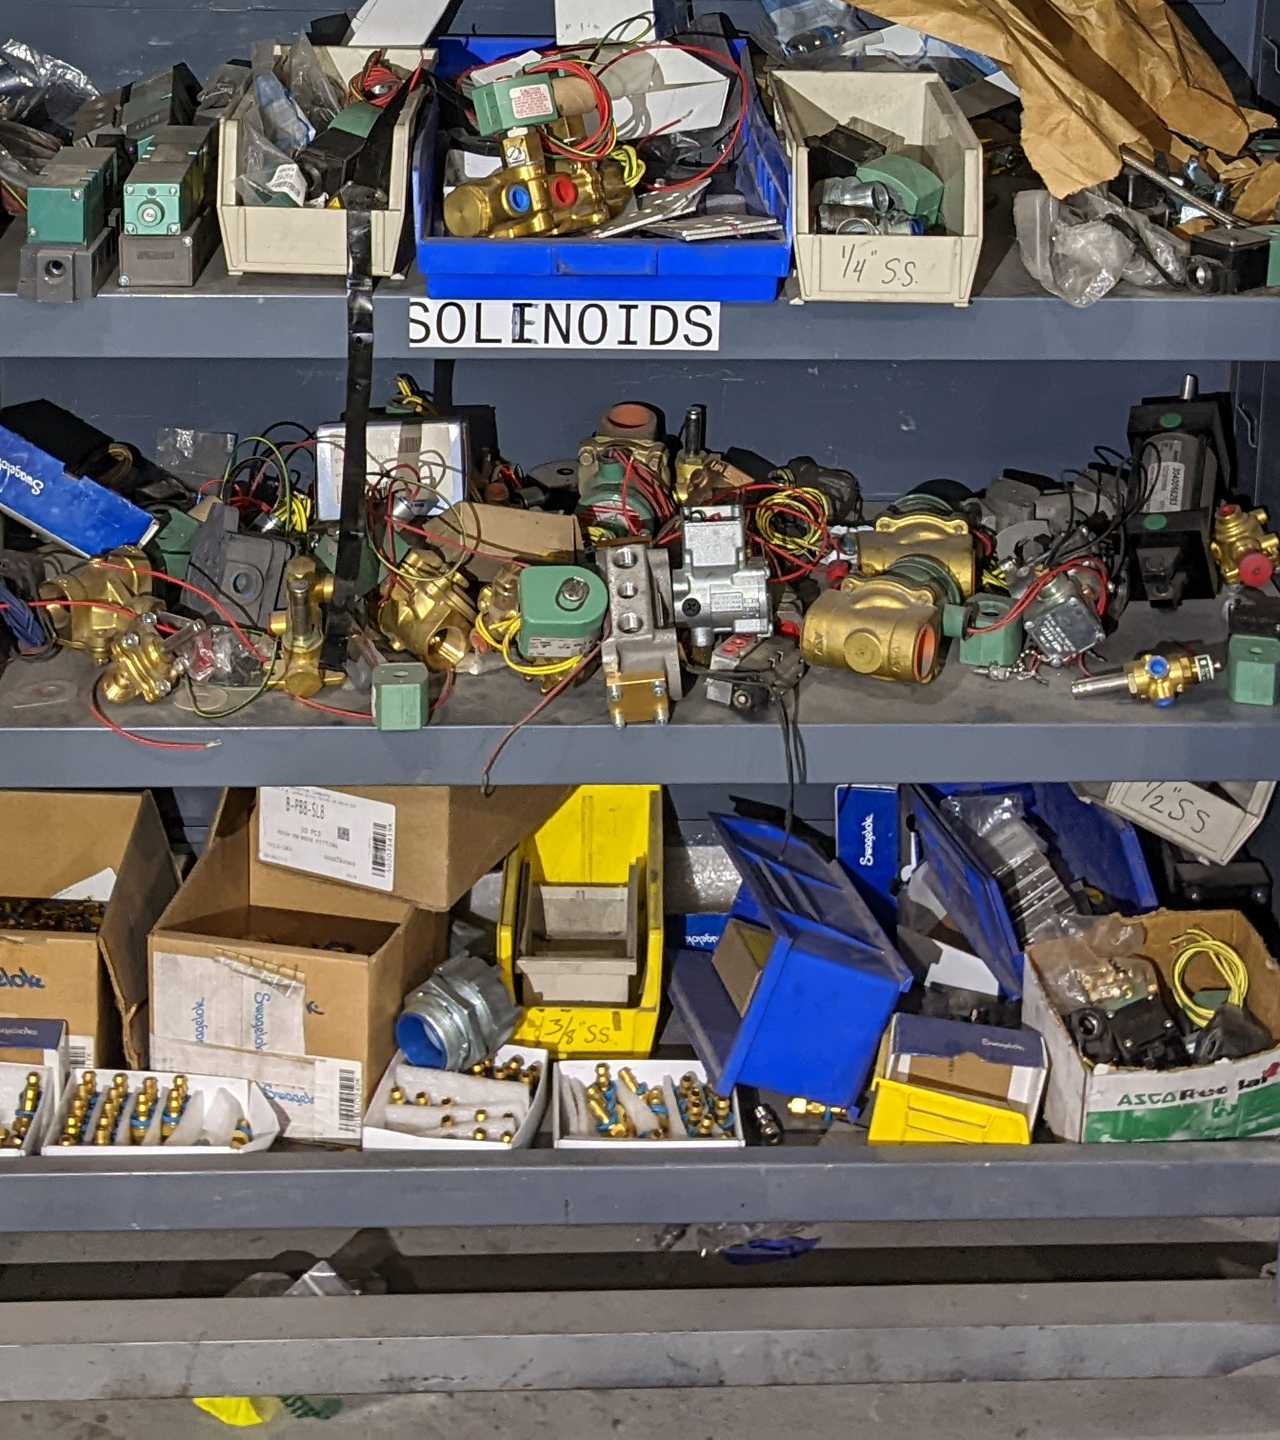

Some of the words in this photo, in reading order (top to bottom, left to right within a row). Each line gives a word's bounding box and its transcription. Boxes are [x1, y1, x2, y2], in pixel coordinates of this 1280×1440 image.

[842, 243, 878, 282] 1/4"
[881, 257, 918, 287] S.S.
[409, 301, 713, 346] SOLENOIDS
[1168, 798, 1211, 833] SS
[859, 812, 874, 867] Swagelok
[584, 1024, 611, 1044] SS
[1117, 1089, 1177, 1107] ASCO
